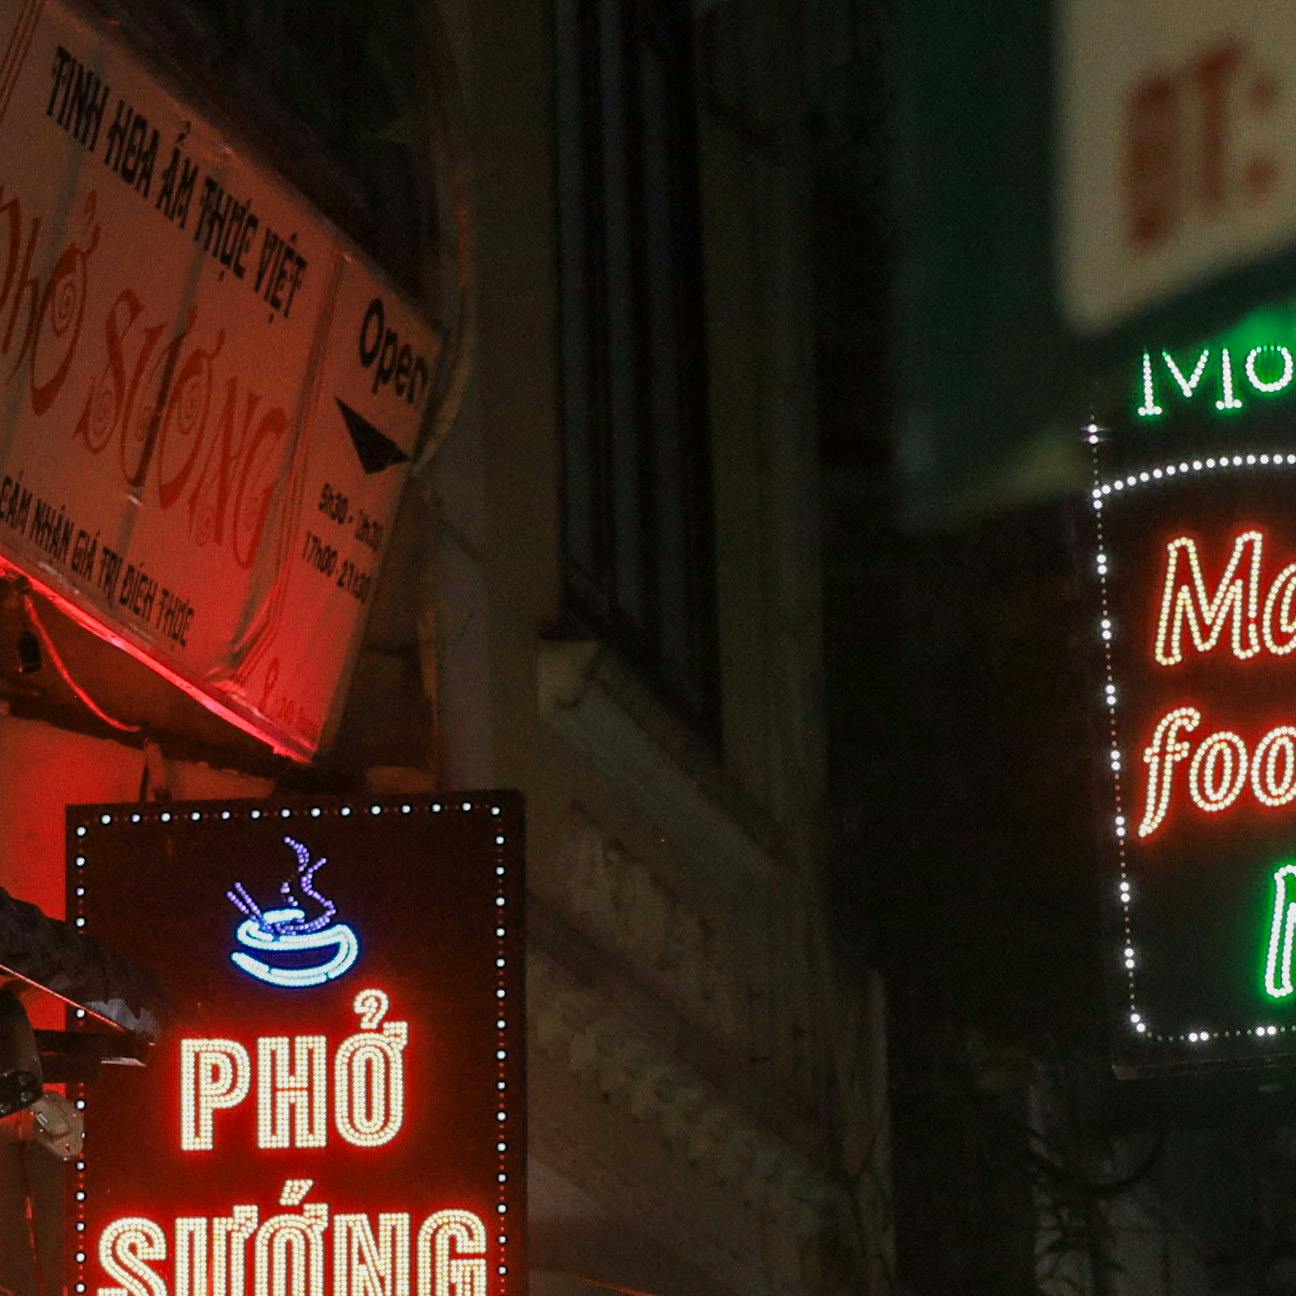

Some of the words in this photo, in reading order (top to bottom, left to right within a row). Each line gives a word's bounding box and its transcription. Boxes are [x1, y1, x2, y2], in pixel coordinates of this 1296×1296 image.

[46, 45, 110, 153] TINH
[103, 100, 161, 200] HOA
[253, 227, 308, 324] VIỆT
[359, 296, 430, 405] Open
[179, 988, 410, 1152] PHỞ
